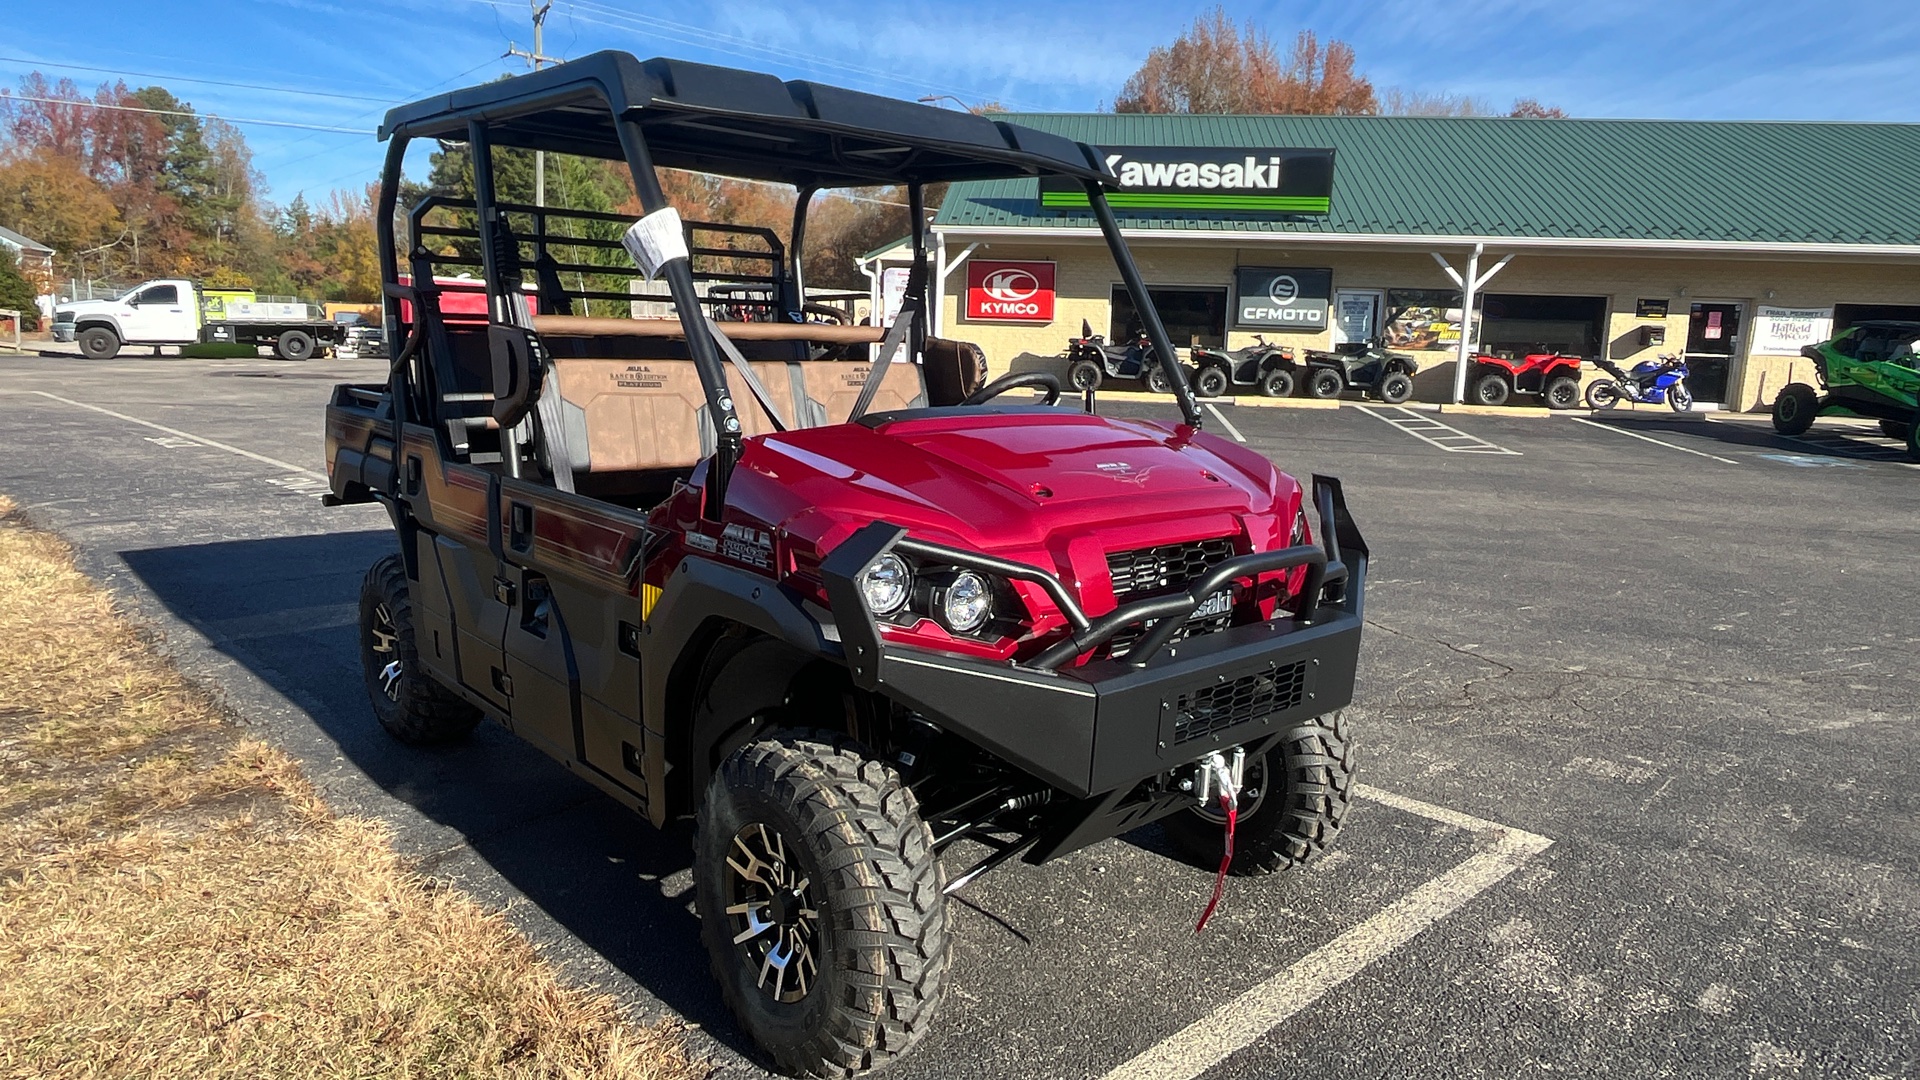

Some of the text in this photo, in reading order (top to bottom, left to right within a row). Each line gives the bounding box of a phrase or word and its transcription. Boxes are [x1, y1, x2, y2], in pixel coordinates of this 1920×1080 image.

[981, 302, 1039, 315] KYMCO
[1243, 307, 1321, 322] CFMOTO
[1771, 322, 1812, 335] Hatfield
